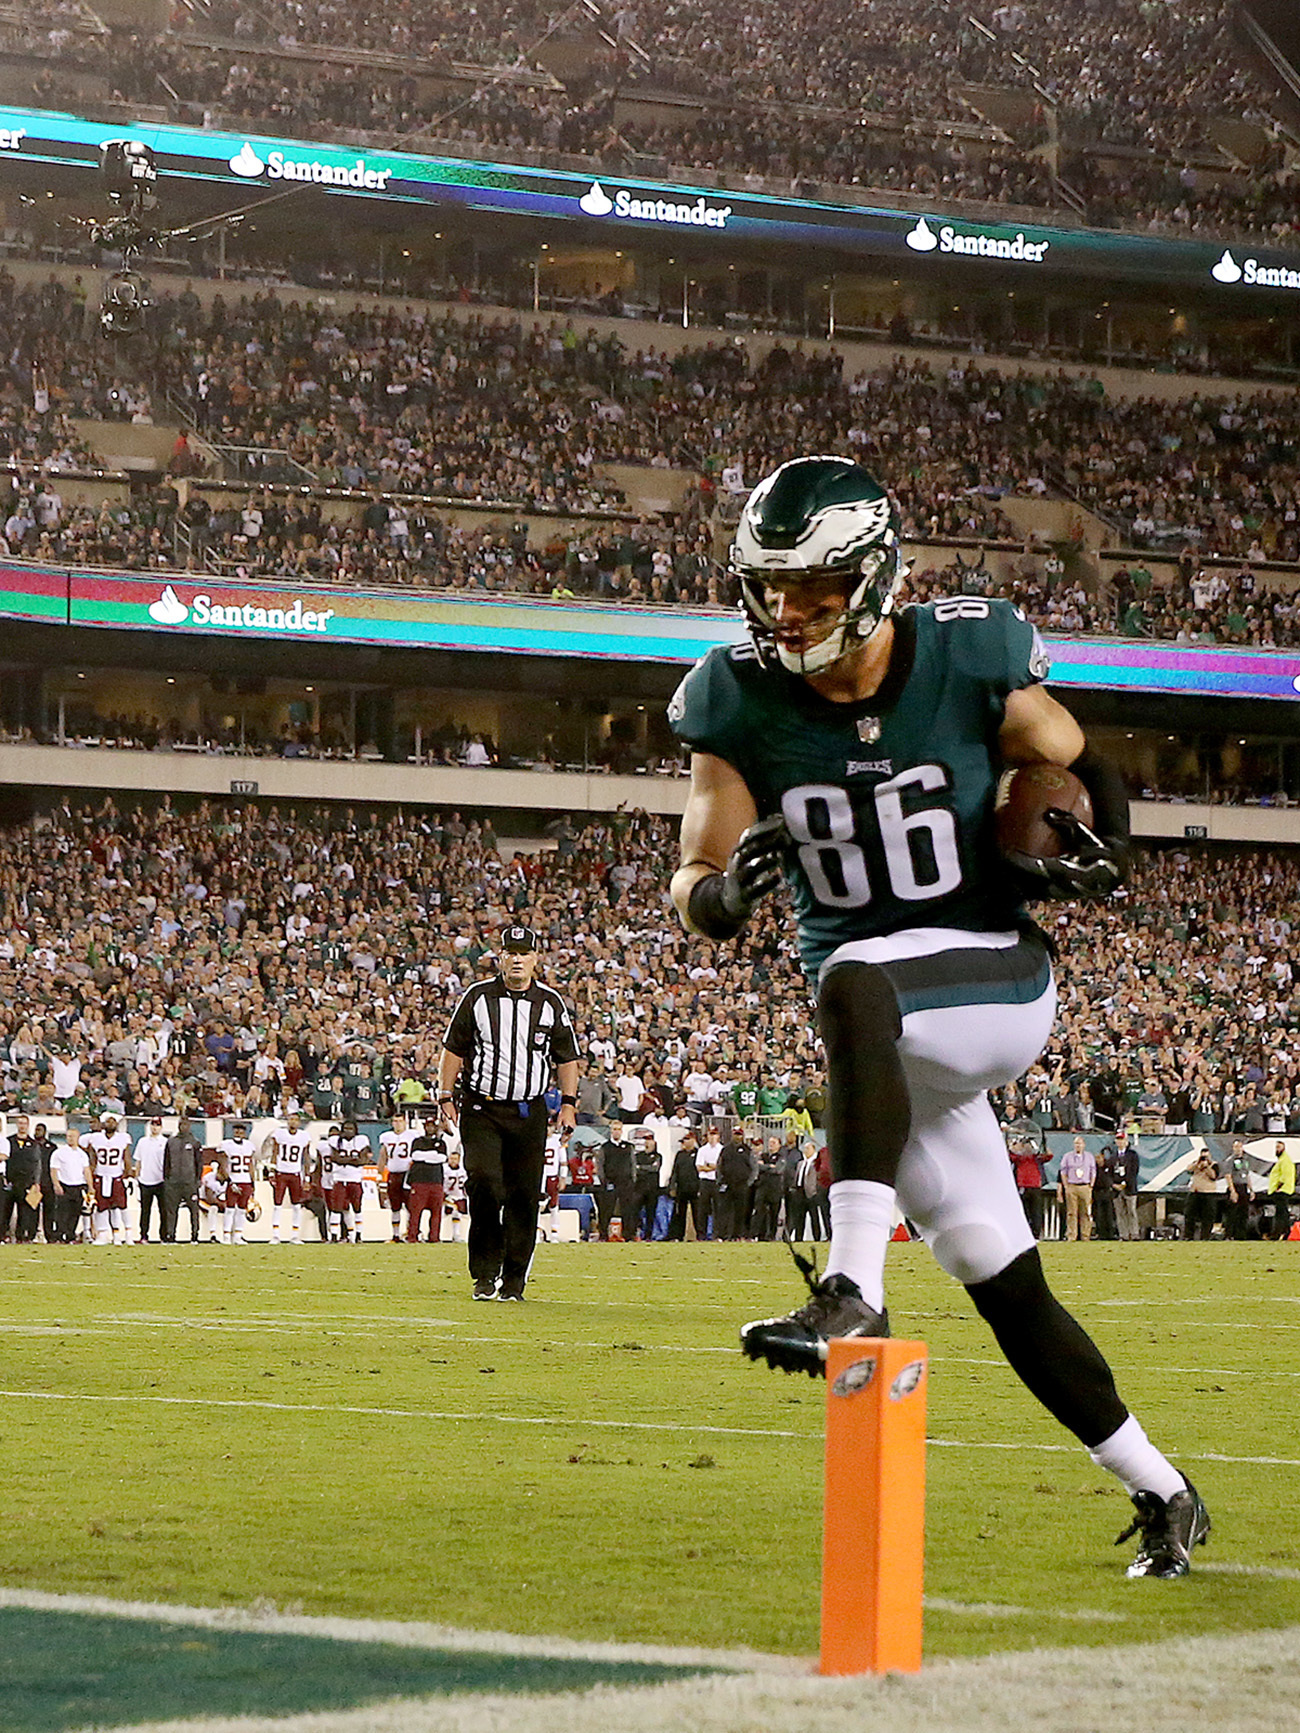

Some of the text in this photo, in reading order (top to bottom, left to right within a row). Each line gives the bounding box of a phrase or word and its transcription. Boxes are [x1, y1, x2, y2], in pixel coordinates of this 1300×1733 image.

[267, 151, 391, 189] Santander
[615, 190, 731, 227] Santander
[939, 226, 1048, 261] Santander
[192, 595, 333, 631] Santander
[235, 782, 254, 793] 117
[781, 764, 962, 908] 86
[740, 1091, 755, 1105] 92
[1040, 1099, 1052, 1113] 11
[97, 1148, 120, 1166] 32
[281, 1145, 300, 1163] 18
[388, 1142, 409, 1158] 73
[230, 1155, 251, 1172] 25
